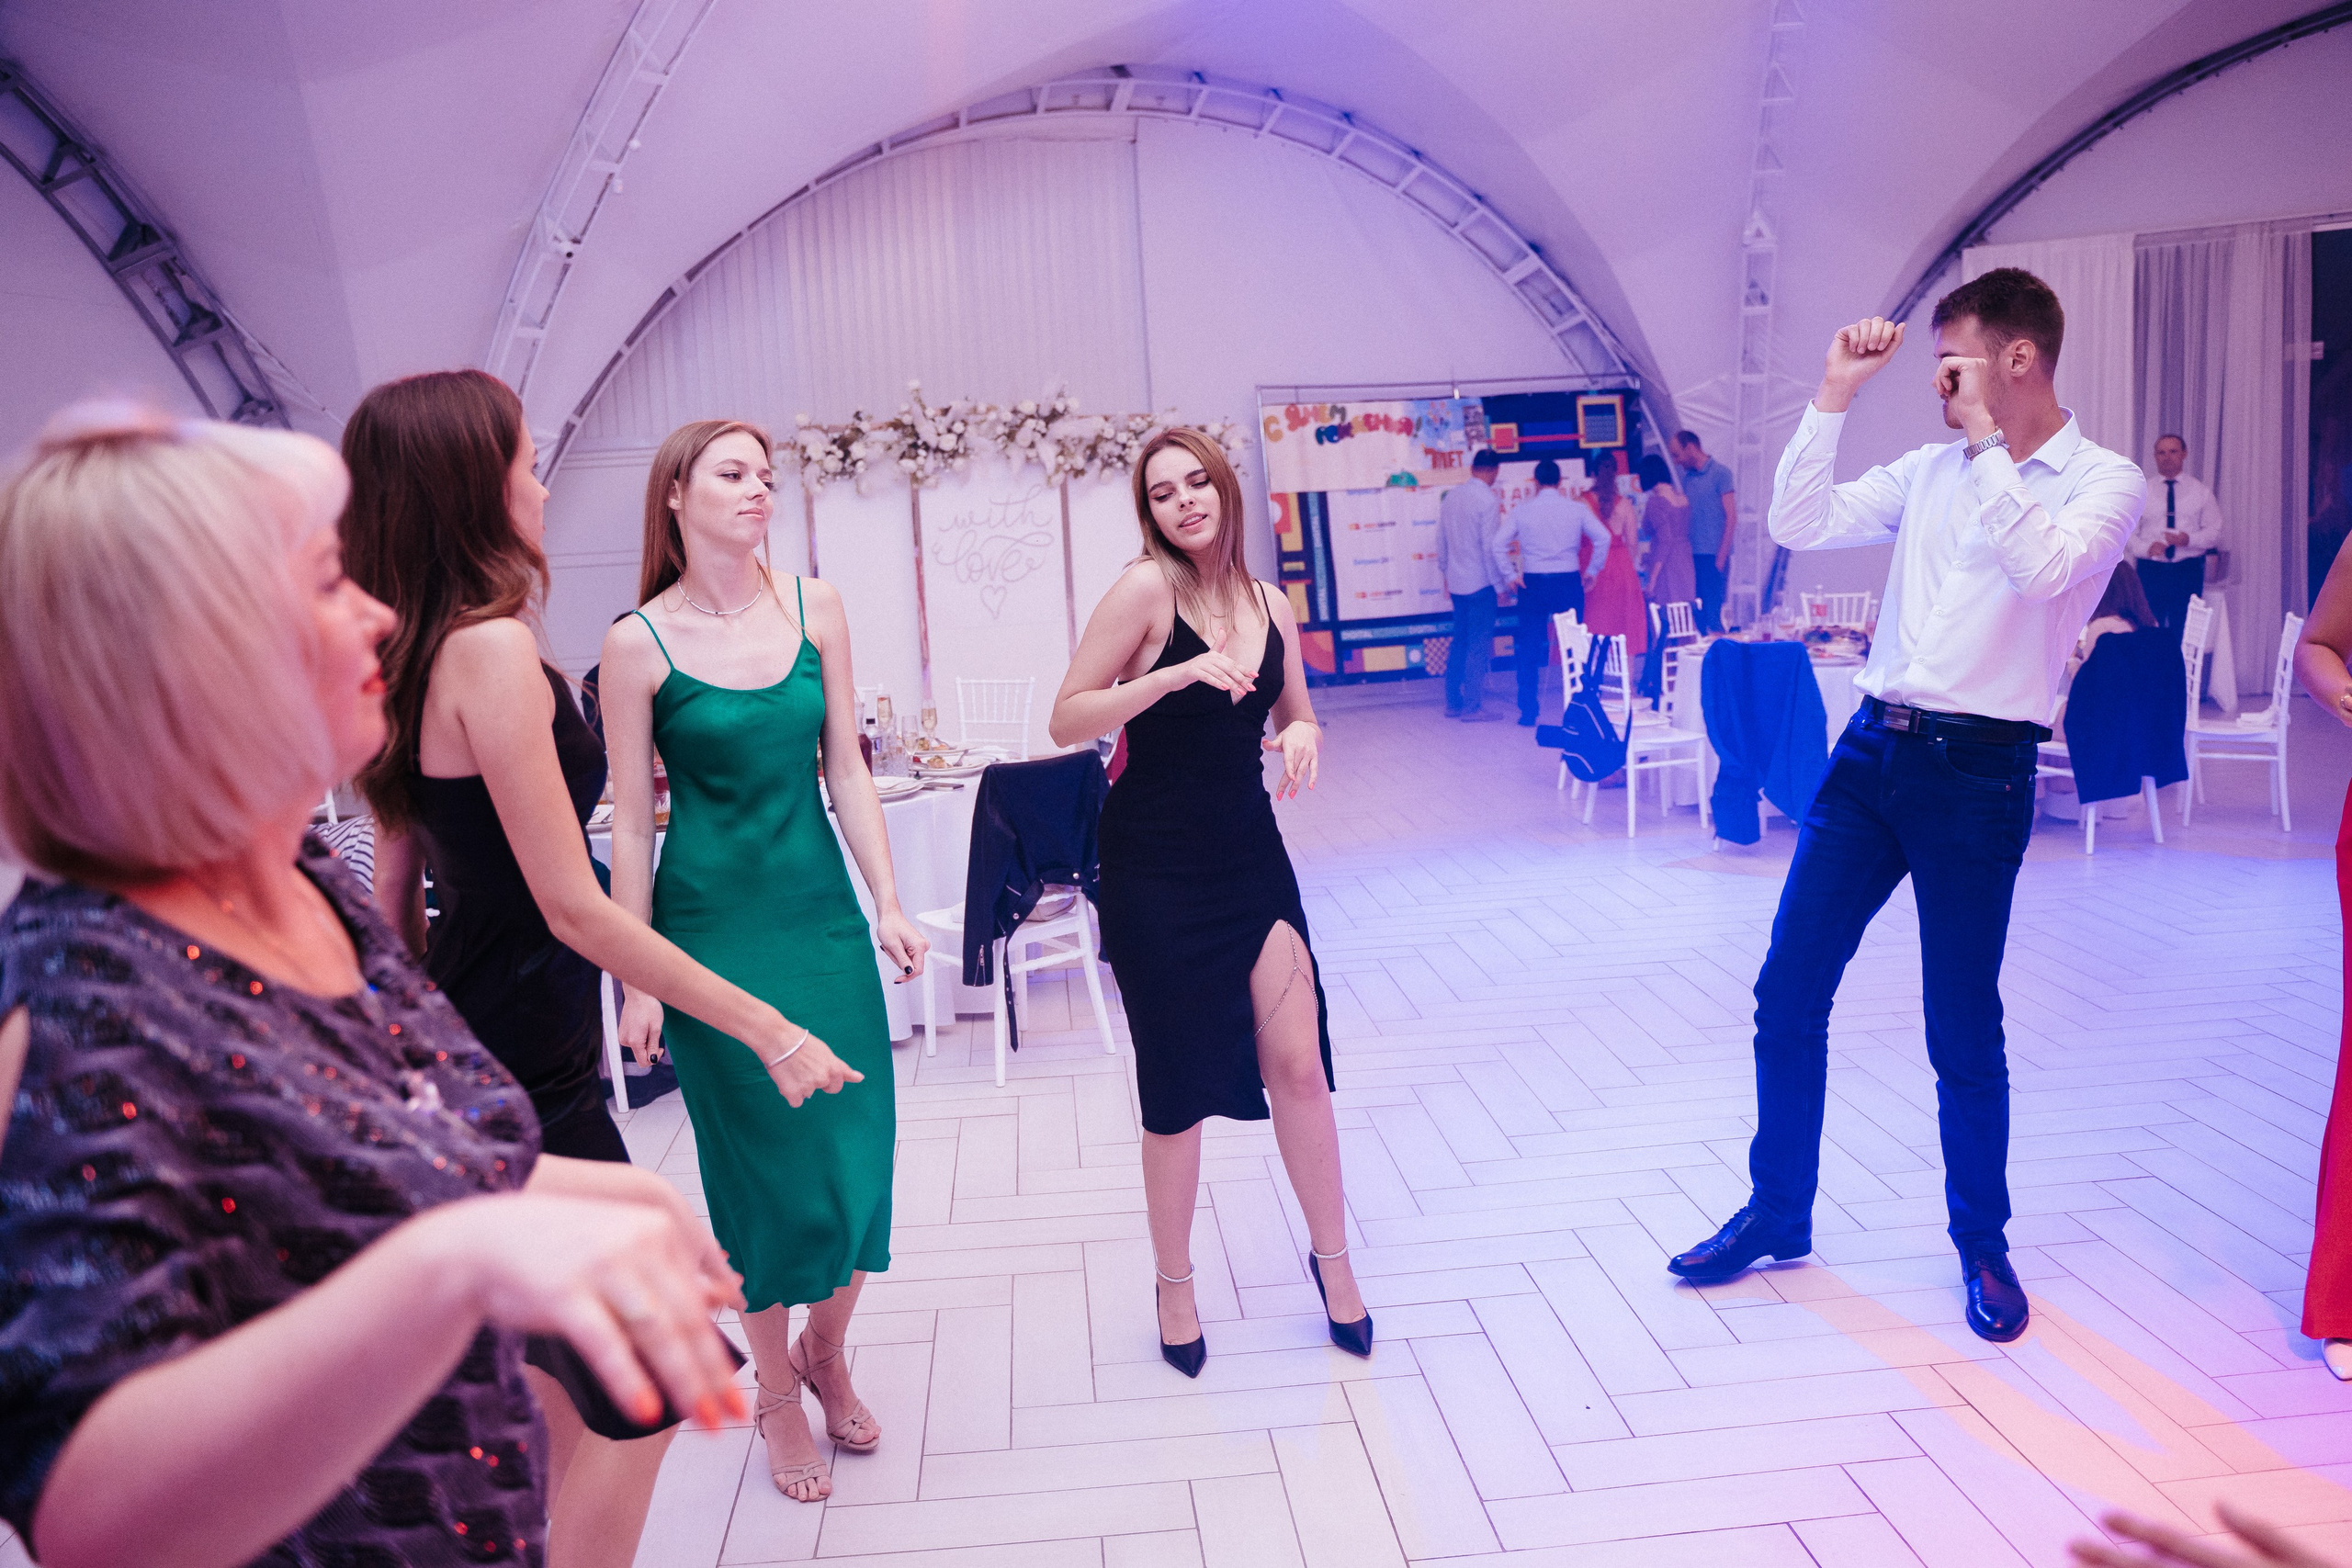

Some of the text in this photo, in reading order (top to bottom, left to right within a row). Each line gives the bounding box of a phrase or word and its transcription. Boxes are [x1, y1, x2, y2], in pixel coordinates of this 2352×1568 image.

[1263, 415, 1283, 443] С
[938, 483, 1054, 532] with
[931, 529, 1055, 583] love
